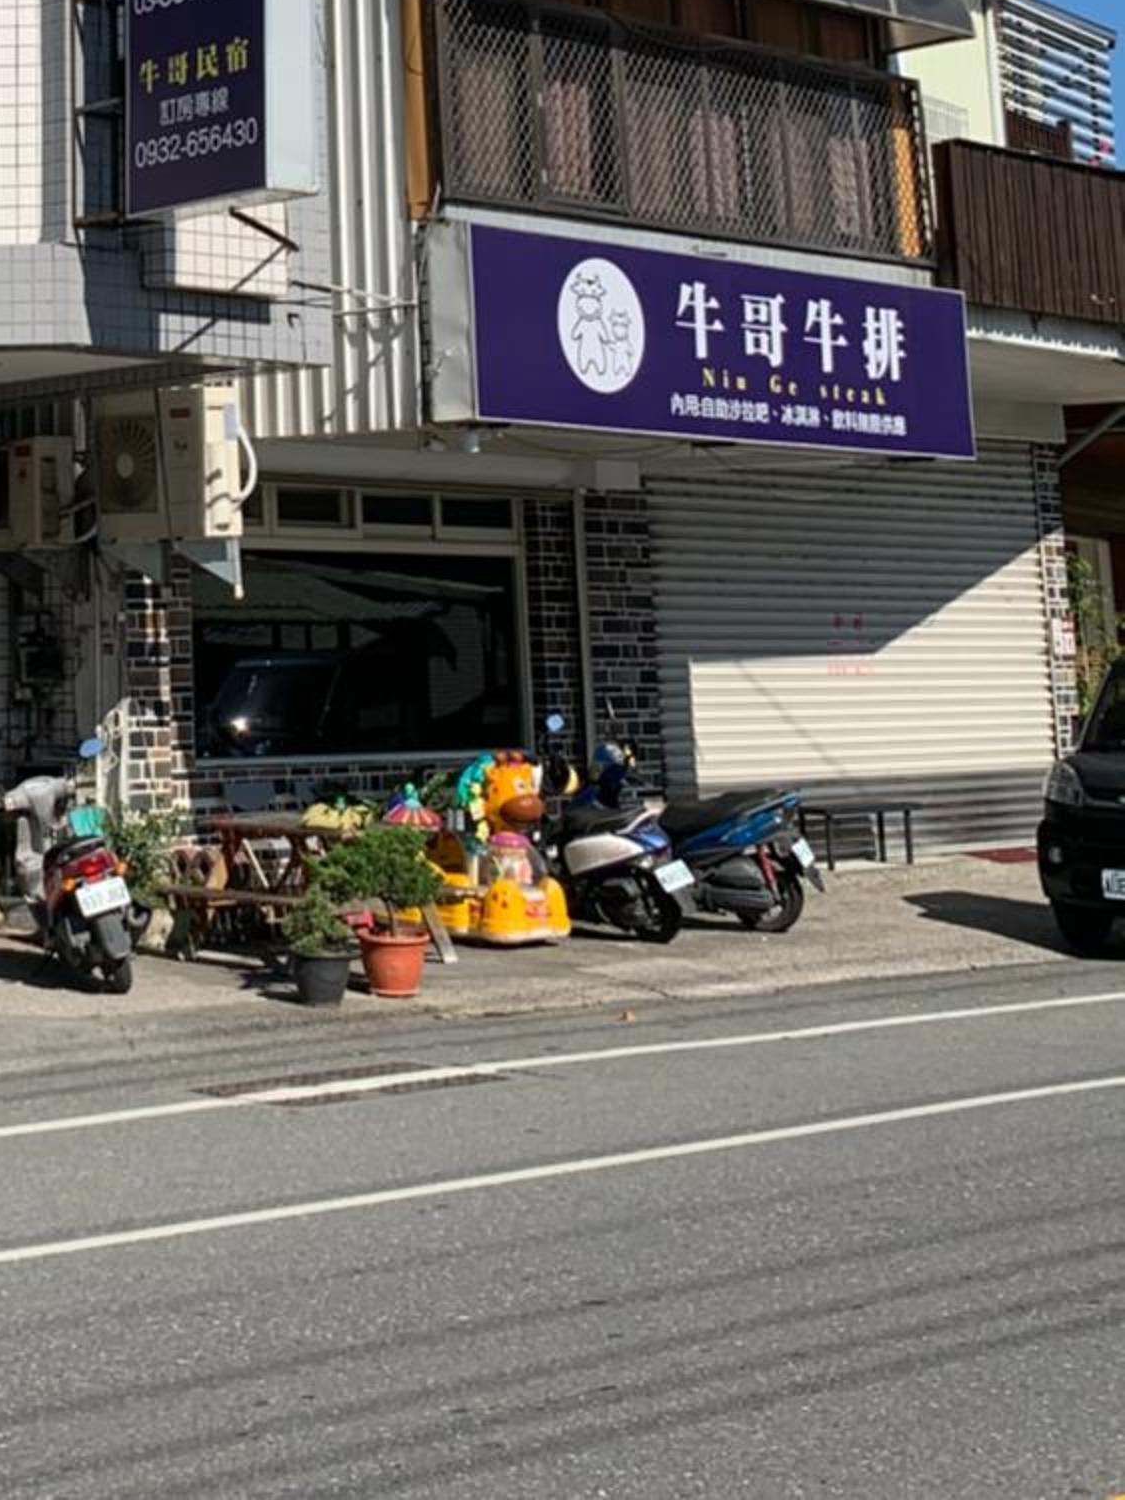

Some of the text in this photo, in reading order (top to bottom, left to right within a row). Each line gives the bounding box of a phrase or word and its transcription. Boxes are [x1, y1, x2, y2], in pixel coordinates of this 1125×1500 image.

[138, 36, 250, 94] 牛哥民宿
[134, 116, 258, 169] 0932-656430
[674, 281, 907, 382] 牛哥牛排
[702, 367, 887, 406] Niu Ge steak
